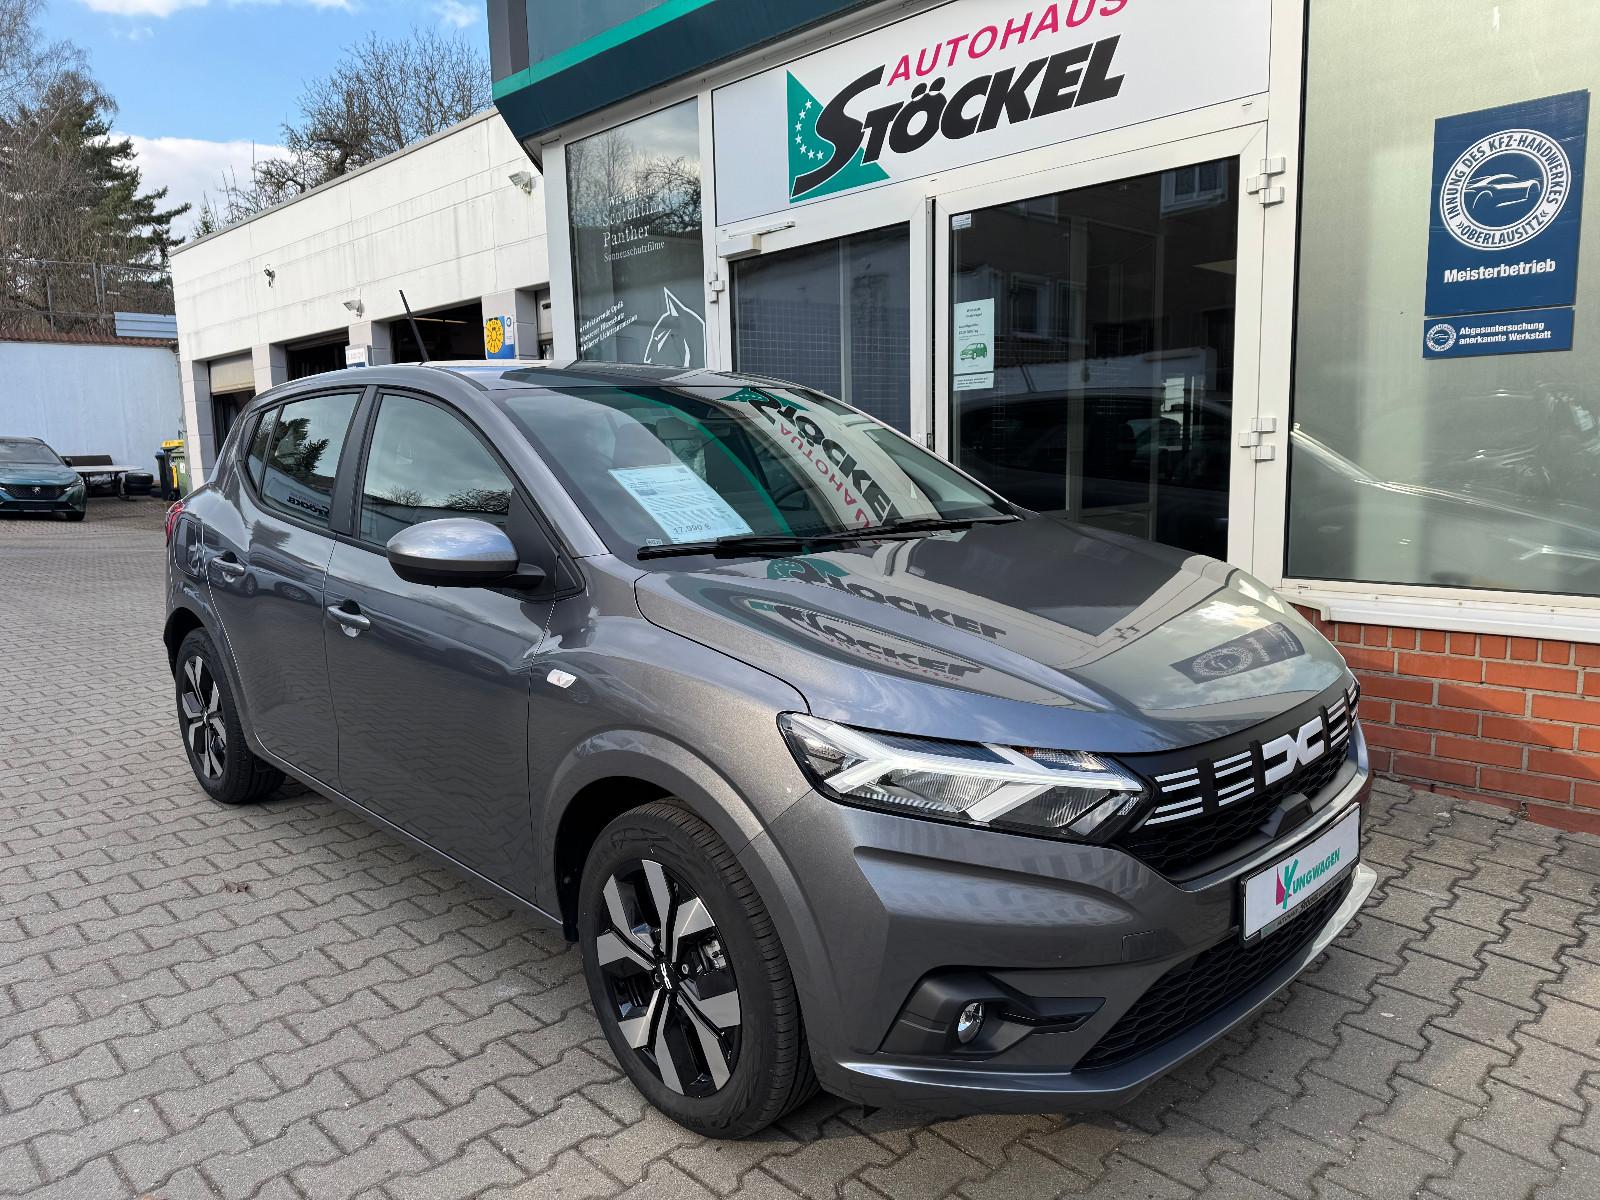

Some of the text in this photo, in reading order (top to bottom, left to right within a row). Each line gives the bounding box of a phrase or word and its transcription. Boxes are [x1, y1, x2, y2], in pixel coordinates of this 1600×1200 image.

[887, 0, 1128, 86] AUTOHAUS
[790, 34, 1126, 198] STÖCKEL
[1446, 134, 1566, 221] INNUNG DES KFZ-HANDWERKES
[603, 225, 650, 247] Panther
[1443, 257, 1556, 284] Meisterbetrieb
[1459, 322, 1545, 335] Abgasuntersuchung
[1459, 330, 1552, 345] anerkannte Werkstatt
